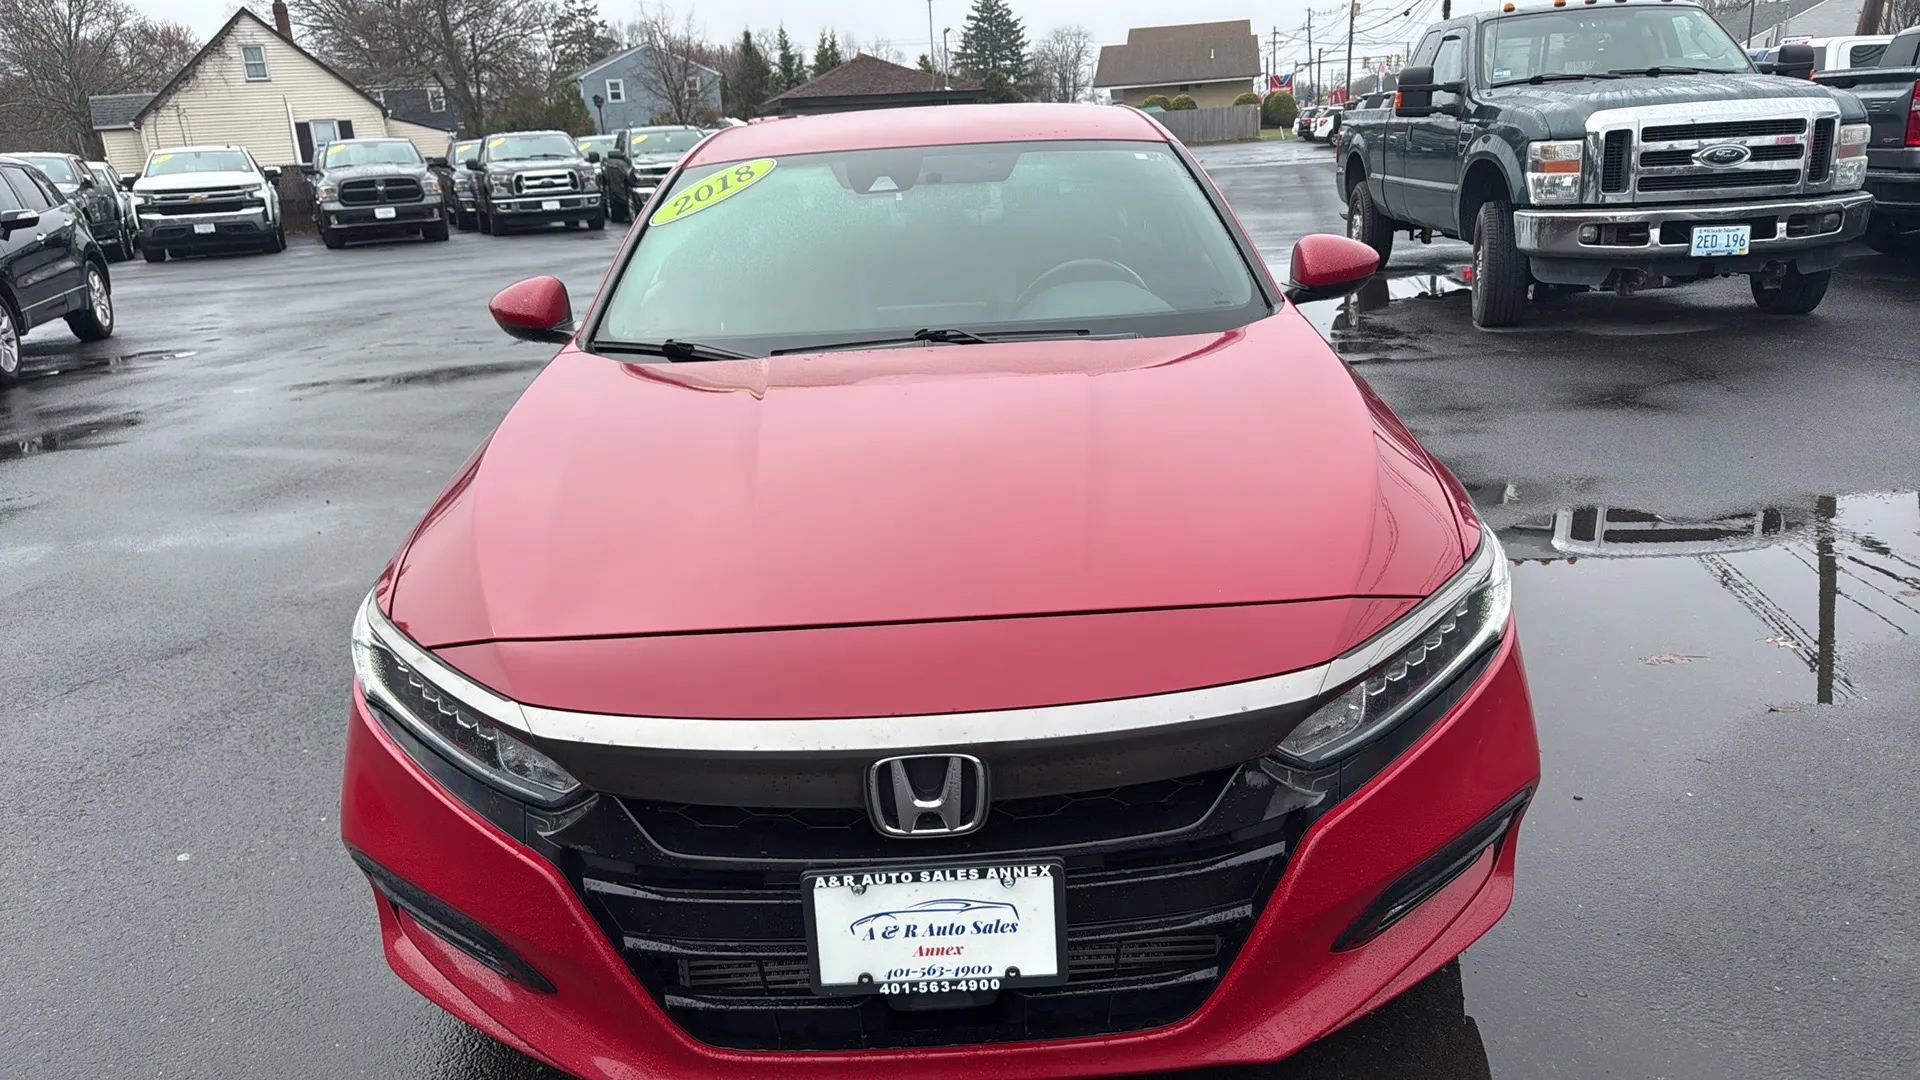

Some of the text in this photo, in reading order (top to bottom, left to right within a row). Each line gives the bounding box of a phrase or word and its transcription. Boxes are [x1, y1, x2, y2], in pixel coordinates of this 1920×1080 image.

[673, 165, 755, 216] 2018
[1696, 233, 1746, 249] 2ED 196
[815, 865, 1052, 889] A&R AUTO SALES ANNEX
[862, 919, 1019, 941] A & R Auto Sales
[912, 945, 965, 958] Annex
[884, 963, 992, 980] 401-563-4900
[879, 979, 1000, 995] 401-563-4900
